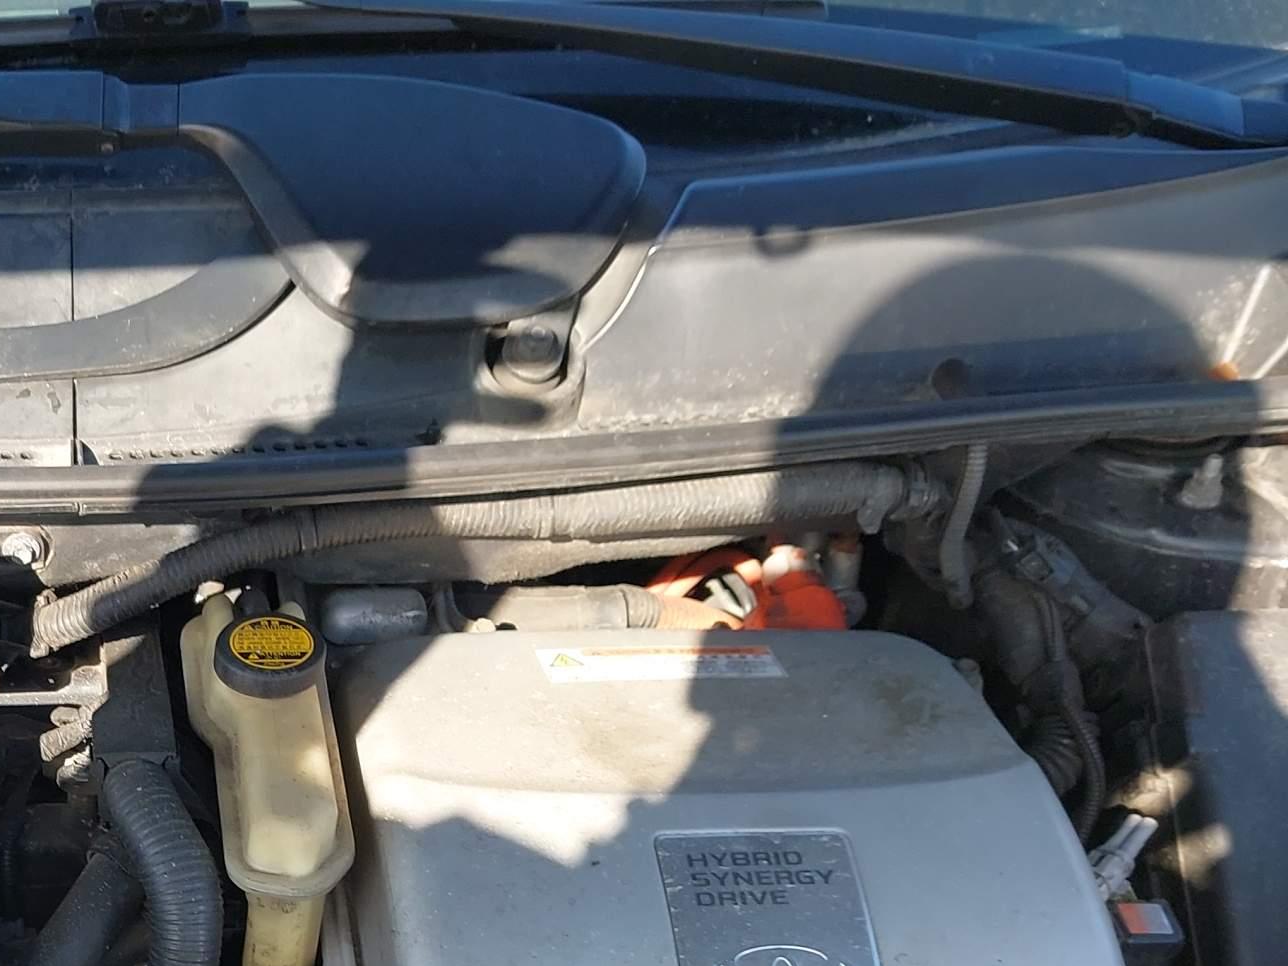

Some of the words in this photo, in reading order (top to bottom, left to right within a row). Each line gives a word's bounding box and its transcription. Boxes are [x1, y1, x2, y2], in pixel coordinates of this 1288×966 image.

[686, 851, 803, 868] HYBRID
[690, 869, 833, 887] SYNERGY
[695, 890, 790, 907] DRIVE
